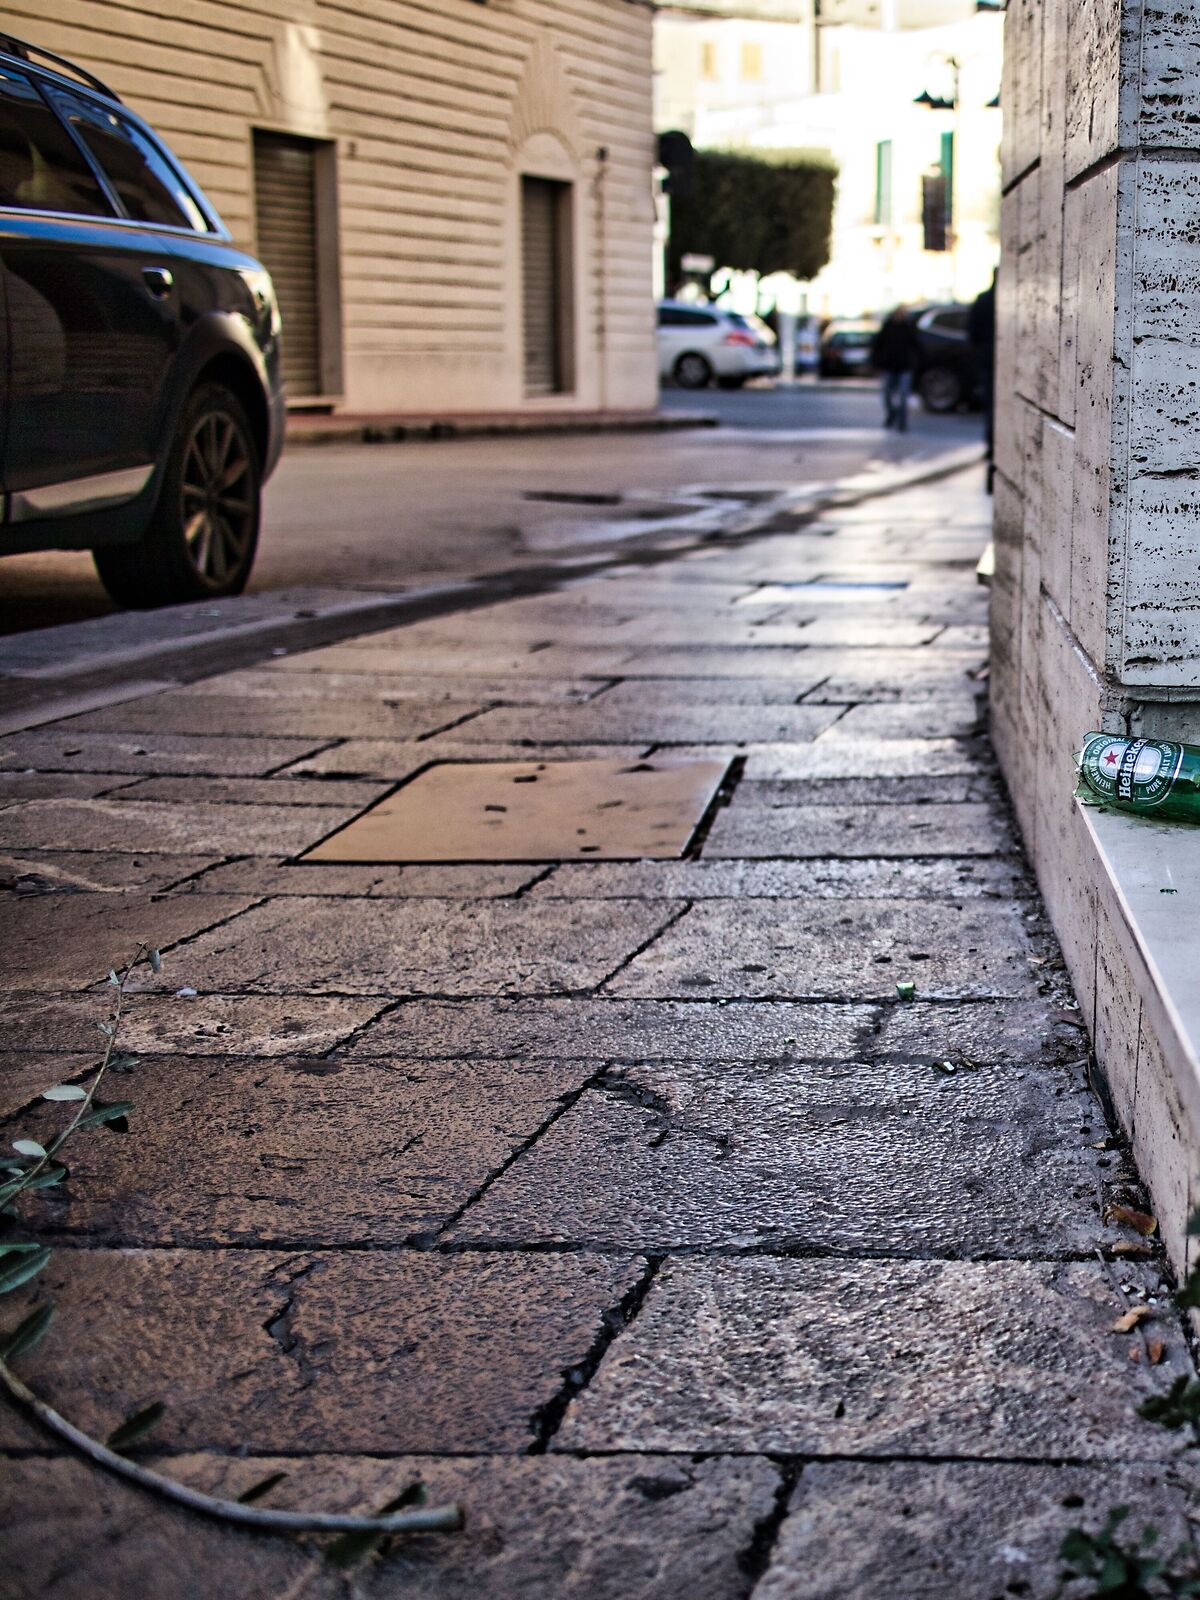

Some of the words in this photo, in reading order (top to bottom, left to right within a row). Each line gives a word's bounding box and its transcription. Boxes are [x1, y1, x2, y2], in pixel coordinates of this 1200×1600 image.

[1092, 737, 1126, 755] ORIGINAL
[1089, 756, 1111, 789] HEINEKEN
[1118, 738, 1149, 798] Heineken
[1145, 778, 1163, 794] PURE
[1158, 758, 1171, 779] MALT
